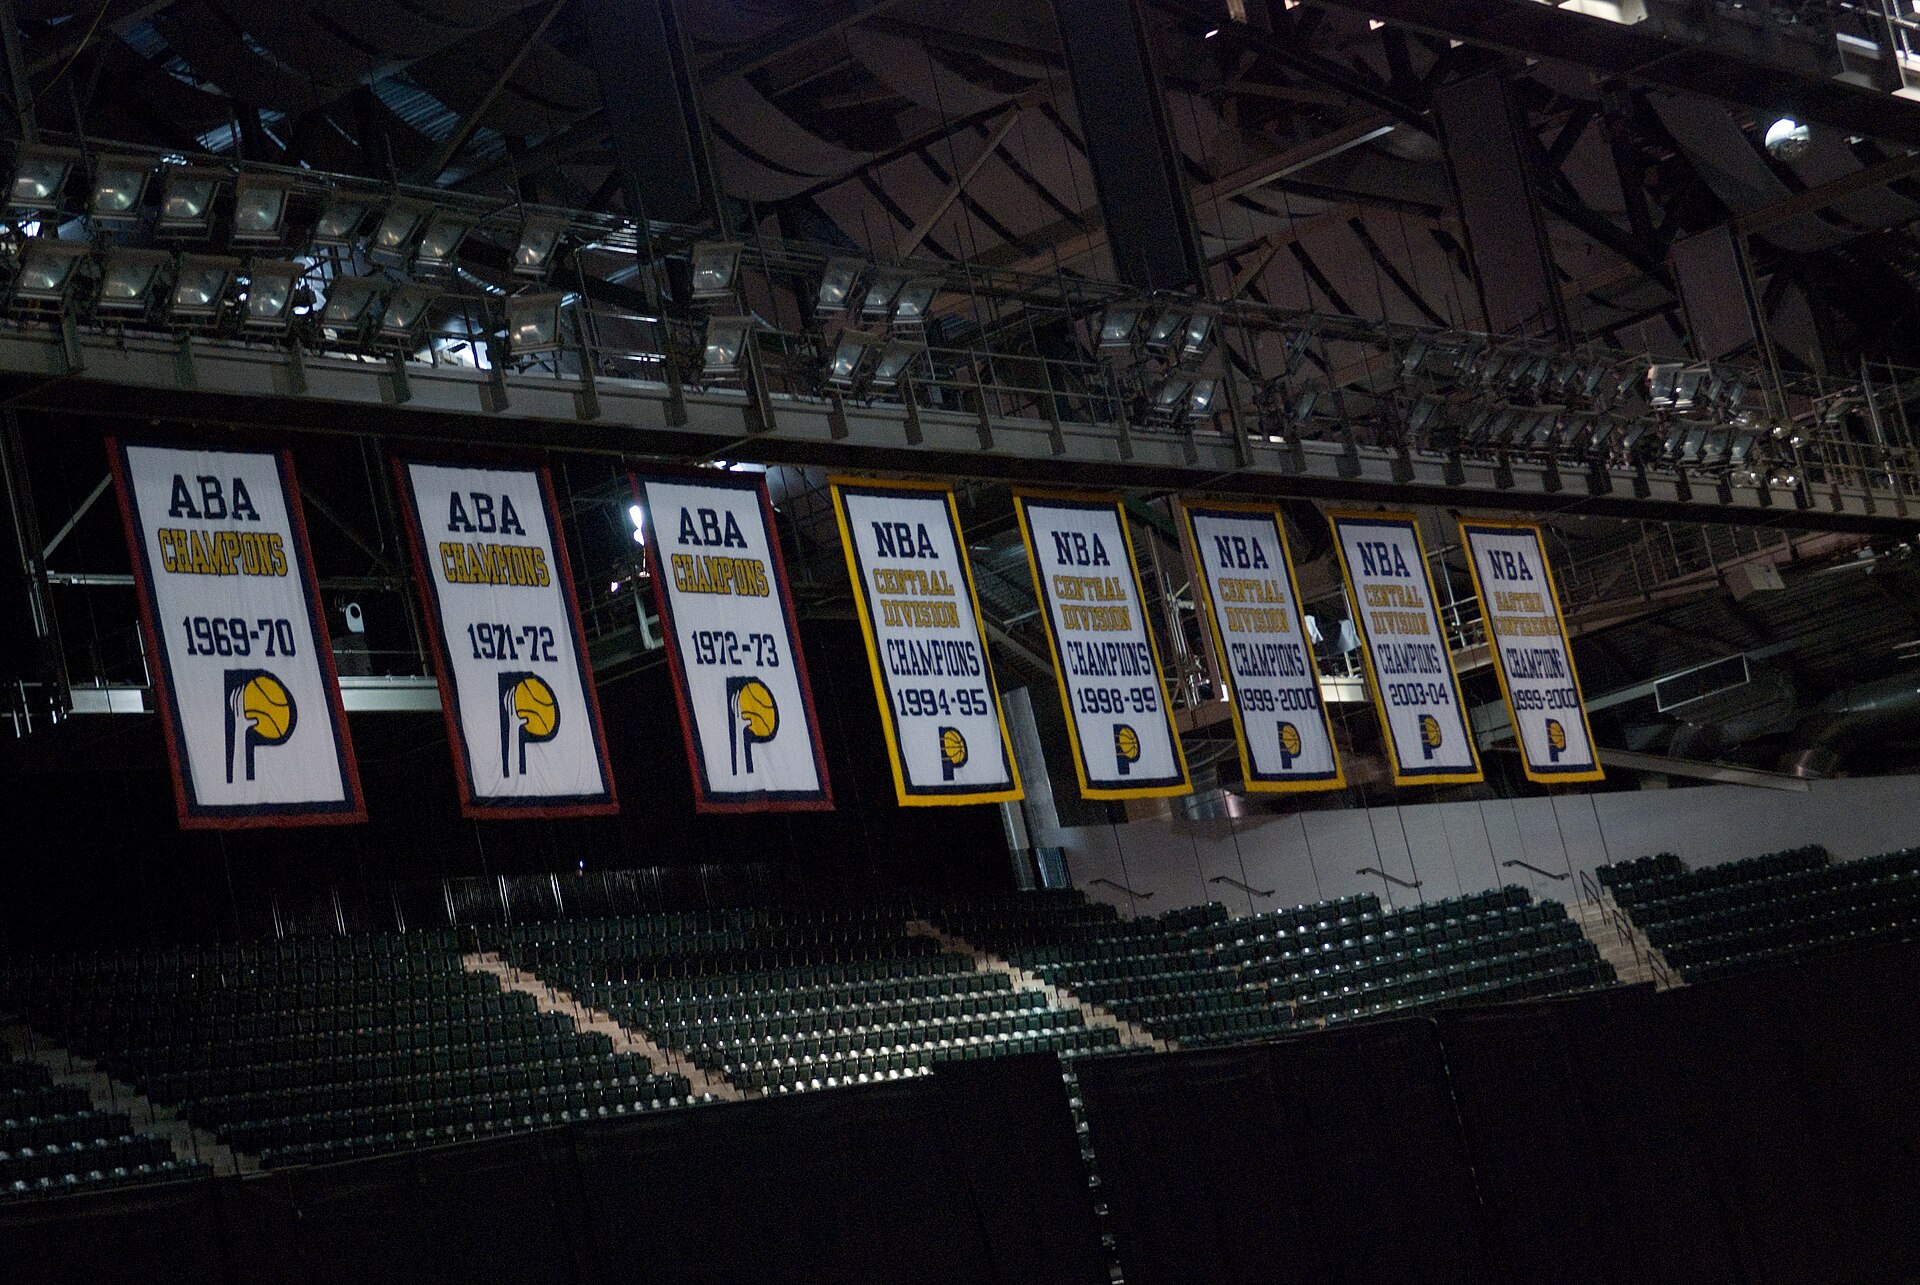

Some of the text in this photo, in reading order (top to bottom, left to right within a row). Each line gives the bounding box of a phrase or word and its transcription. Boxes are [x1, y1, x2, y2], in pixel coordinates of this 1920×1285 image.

[168, 474, 260, 521] ABA
[448, 492, 526, 536] ABA
[678, 507, 747, 548] ABA
[872, 521, 939, 559] NBA
[158, 528, 288, 577] CHAMPIONS
[439, 542, 550, 587] CHAMPIONS
[1051, 531, 1110, 566] NBA
[1214, 535, 1269, 569] NBA
[1357, 542, 1410, 577] NBA
[1488, 550, 1533, 581] NBA
[671, 554, 769, 597] CHAMPIONS
[873, 568, 955, 596] CENTRAL
[1053, 575, 1127, 601] CENTRAL
[1218, 578, 1284, 603] CENTRAL
[1363, 584, 1423, 608] CENTRAL
[880, 600, 960, 628] DIVISION
[1060, 605, 1132, 631] DIVISION
[1224, 607, 1290, 632] DIVISION
[1370, 611, 1430, 635] DIVISION
[183, 616, 295, 657] 1969-70
[468, 623, 558, 662] 1971-72
[692, 631, 779, 667] 1972-73
[887, 639, 980, 676] CHAMPIONS
[1067, 641, 1150, 676] CHAMPIONS
[1232, 643, 1305, 677] CHAMPIONS
[1377, 643, 1441, 674] CHAMPIONS
[898, 689, 987, 716] 1994-95
[1077, 687, 1157, 714] 1998-99
[1239, 688, 1317, 711] 1999-2000
[1389, 683, 1449, 706] 2003-04
